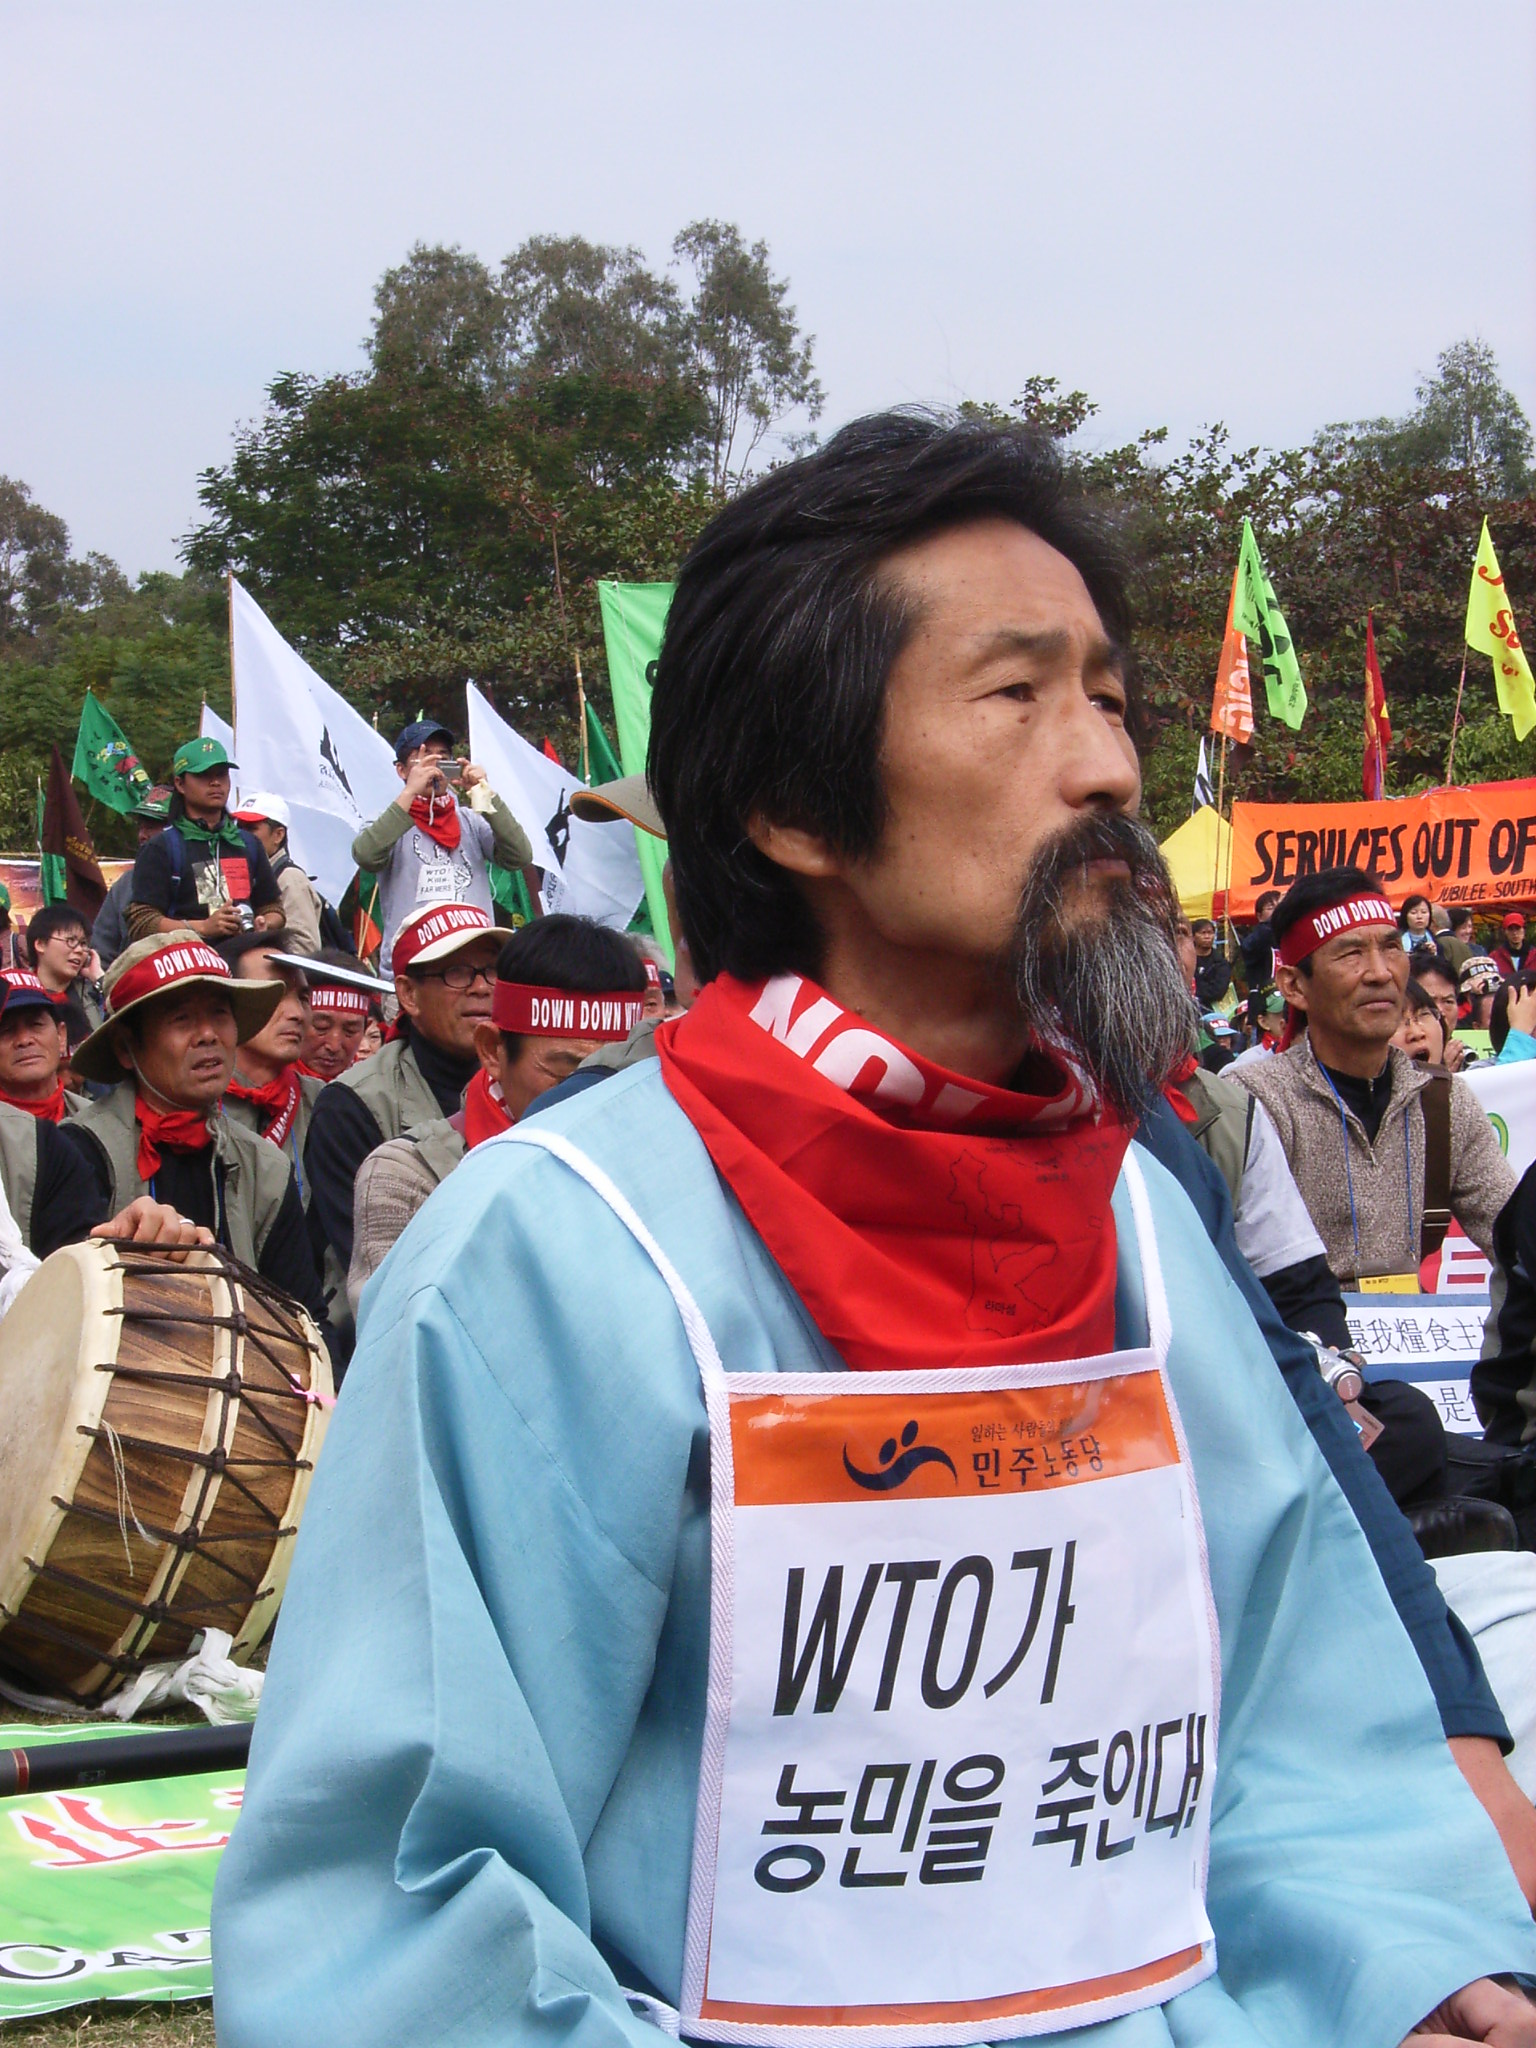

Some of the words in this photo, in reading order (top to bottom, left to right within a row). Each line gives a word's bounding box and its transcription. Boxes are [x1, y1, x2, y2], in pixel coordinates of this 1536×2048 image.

[1250, 826, 1407, 886] SERVICES
[1412, 819, 1479, 879] OUT
[1432, 883, 1487, 903] JUBILEE
[417, 914, 449, 945] DOWN
[445, 909, 480, 929] DOWN
[1312, 905, 1351, 938] DOWN
[1348, 899, 1386, 921] DOWN
[153, 948, 195, 979] DOWN
[312, 990, 335, 1007] DOWN
[336, 991, 359, 1009] DOWN
[531, 997, 575, 1029] DOWN
[580, 1000, 622, 1031] DOWN
[972, 1434, 1103, 1488] 민주노동당
[772, 1539, 1077, 1717] WTO가
[753, 1753, 1006, 1894] 농민을
